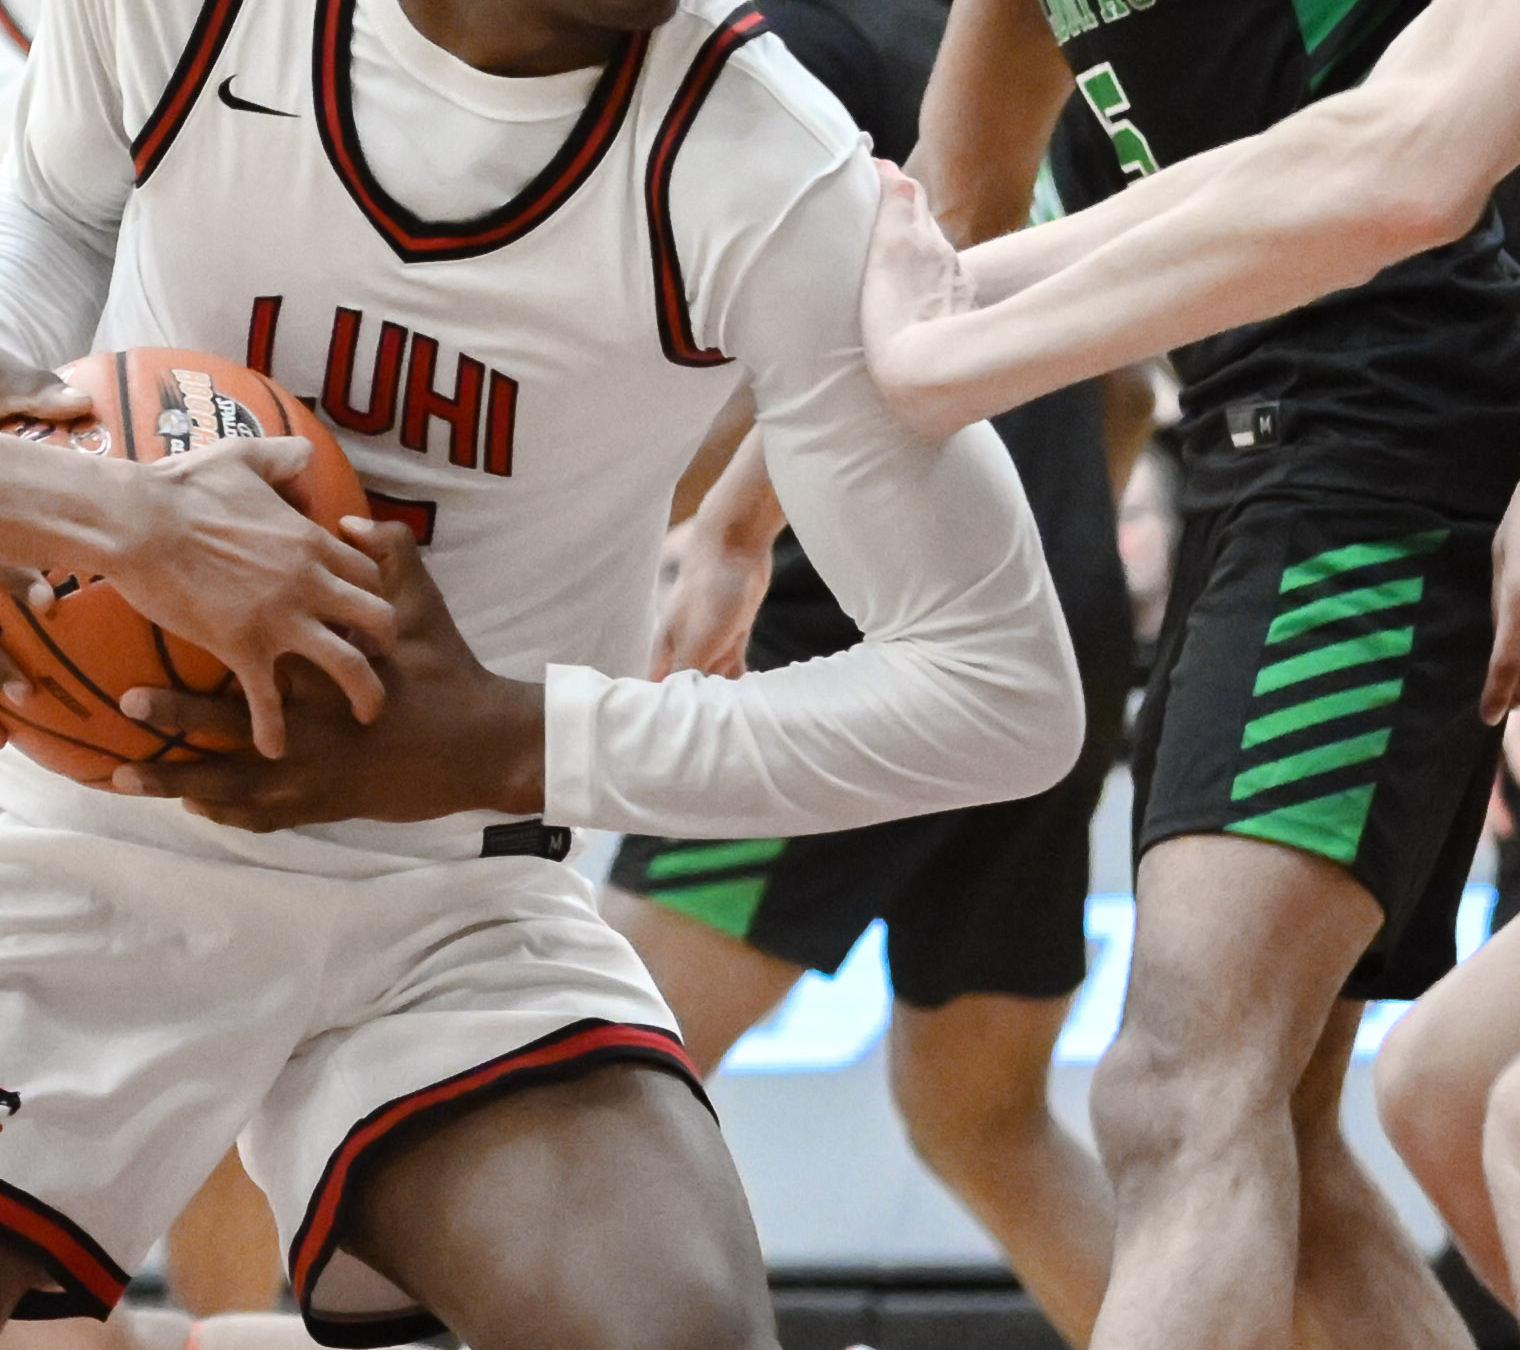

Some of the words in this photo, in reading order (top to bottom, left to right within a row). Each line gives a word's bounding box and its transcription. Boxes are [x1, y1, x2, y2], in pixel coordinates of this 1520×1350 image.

[1075, 61, 1160, 188] 5
[170, 369, 220, 450] HOOPH
[246, 295, 519, 478] LUHI
